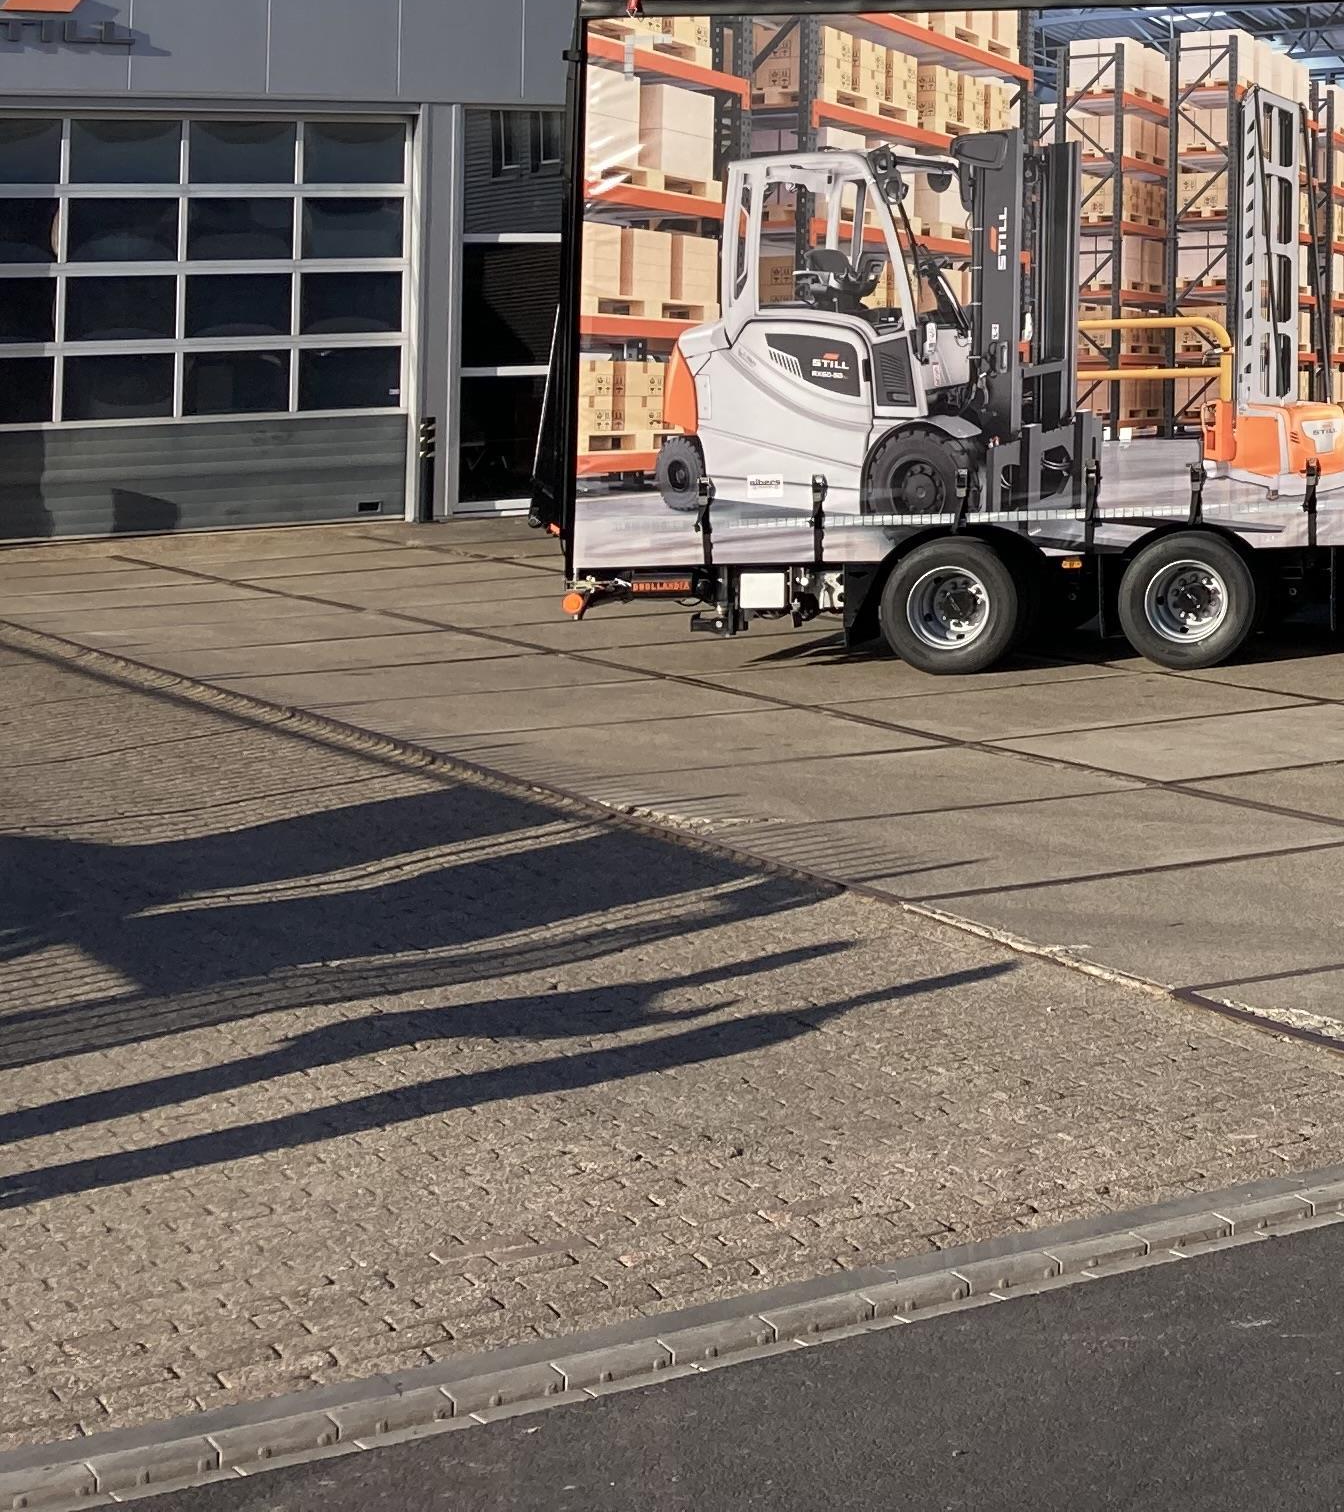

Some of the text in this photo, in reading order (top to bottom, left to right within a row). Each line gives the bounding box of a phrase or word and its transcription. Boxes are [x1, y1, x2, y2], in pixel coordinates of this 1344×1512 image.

[0, 19, 136, 44] TILL
[997, 206, 1008, 271] STILL
[812, 358, 850, 370] STILL
